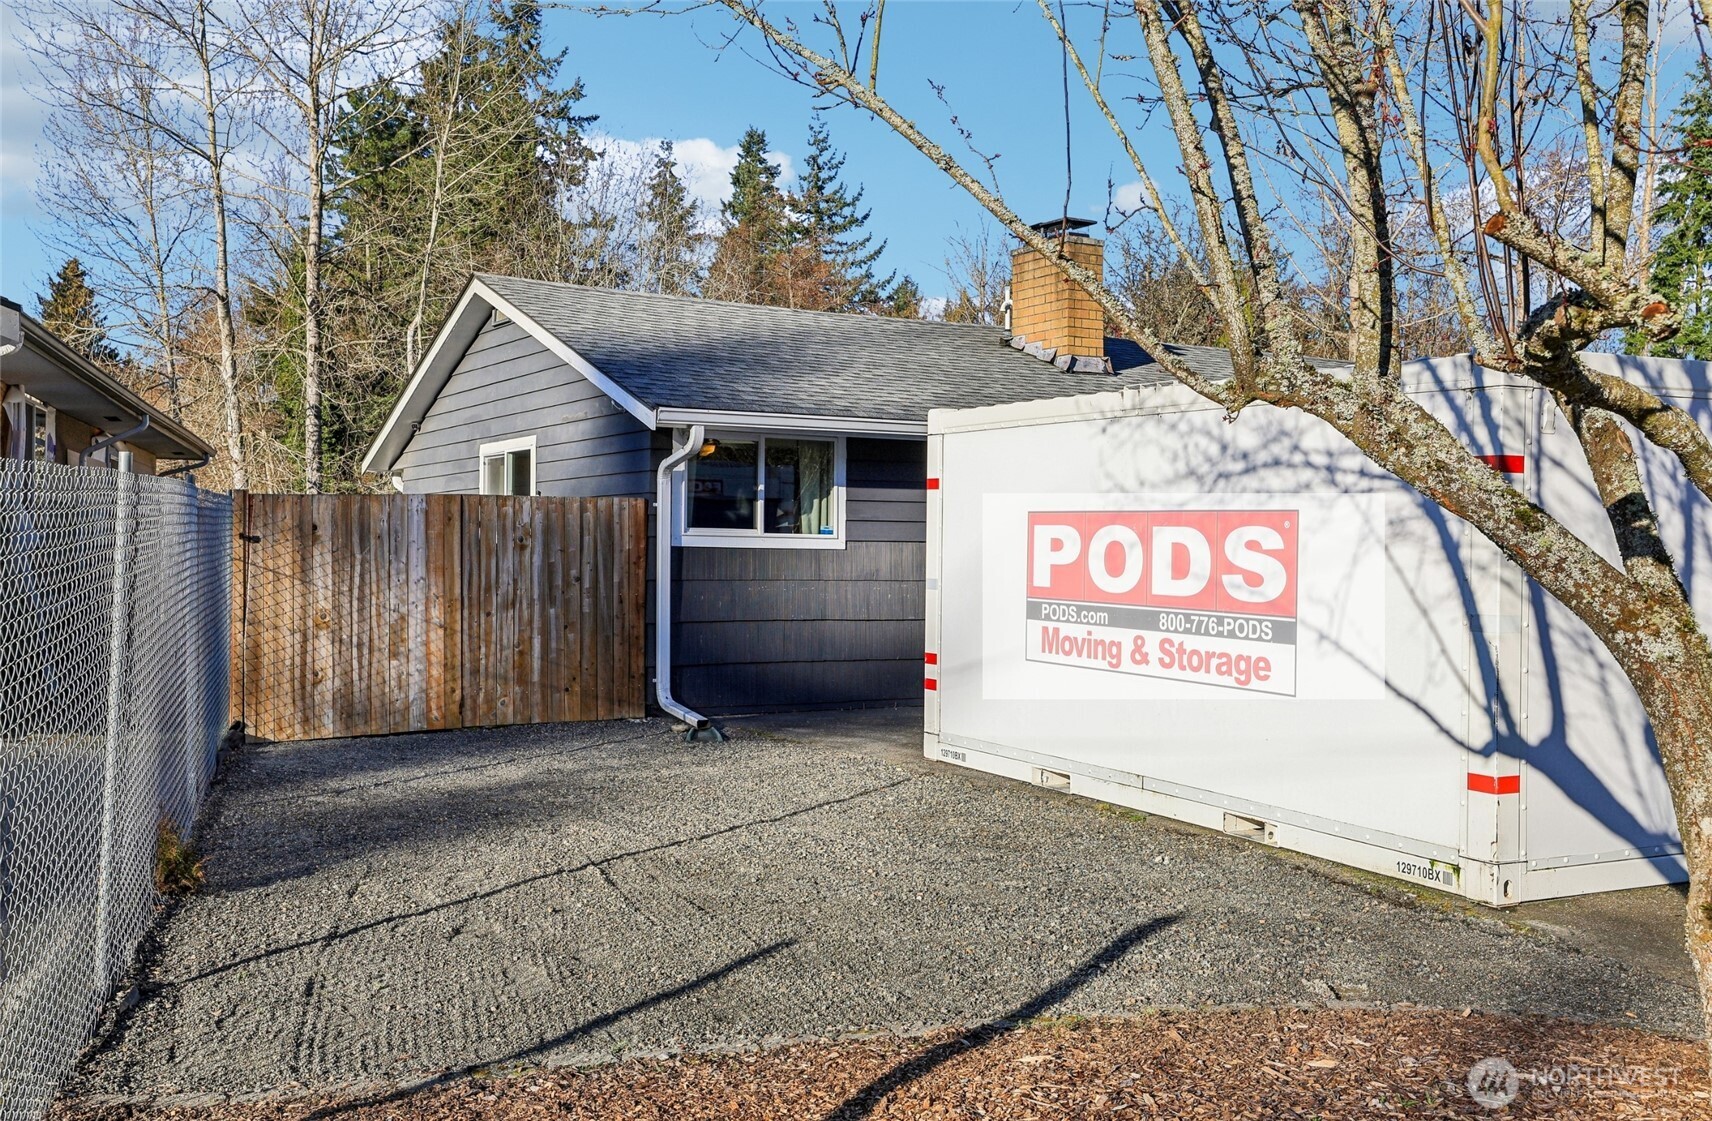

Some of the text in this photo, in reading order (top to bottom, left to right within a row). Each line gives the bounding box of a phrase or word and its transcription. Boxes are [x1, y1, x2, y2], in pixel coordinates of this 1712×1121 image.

[1032, 523, 1288, 604] PODS
[1041, 603, 1273, 641] PODS.com 800-776-PODS
[1041, 626, 1272, 687] Moving & Storage
[1396, 860, 1442, 883] 129710BX
